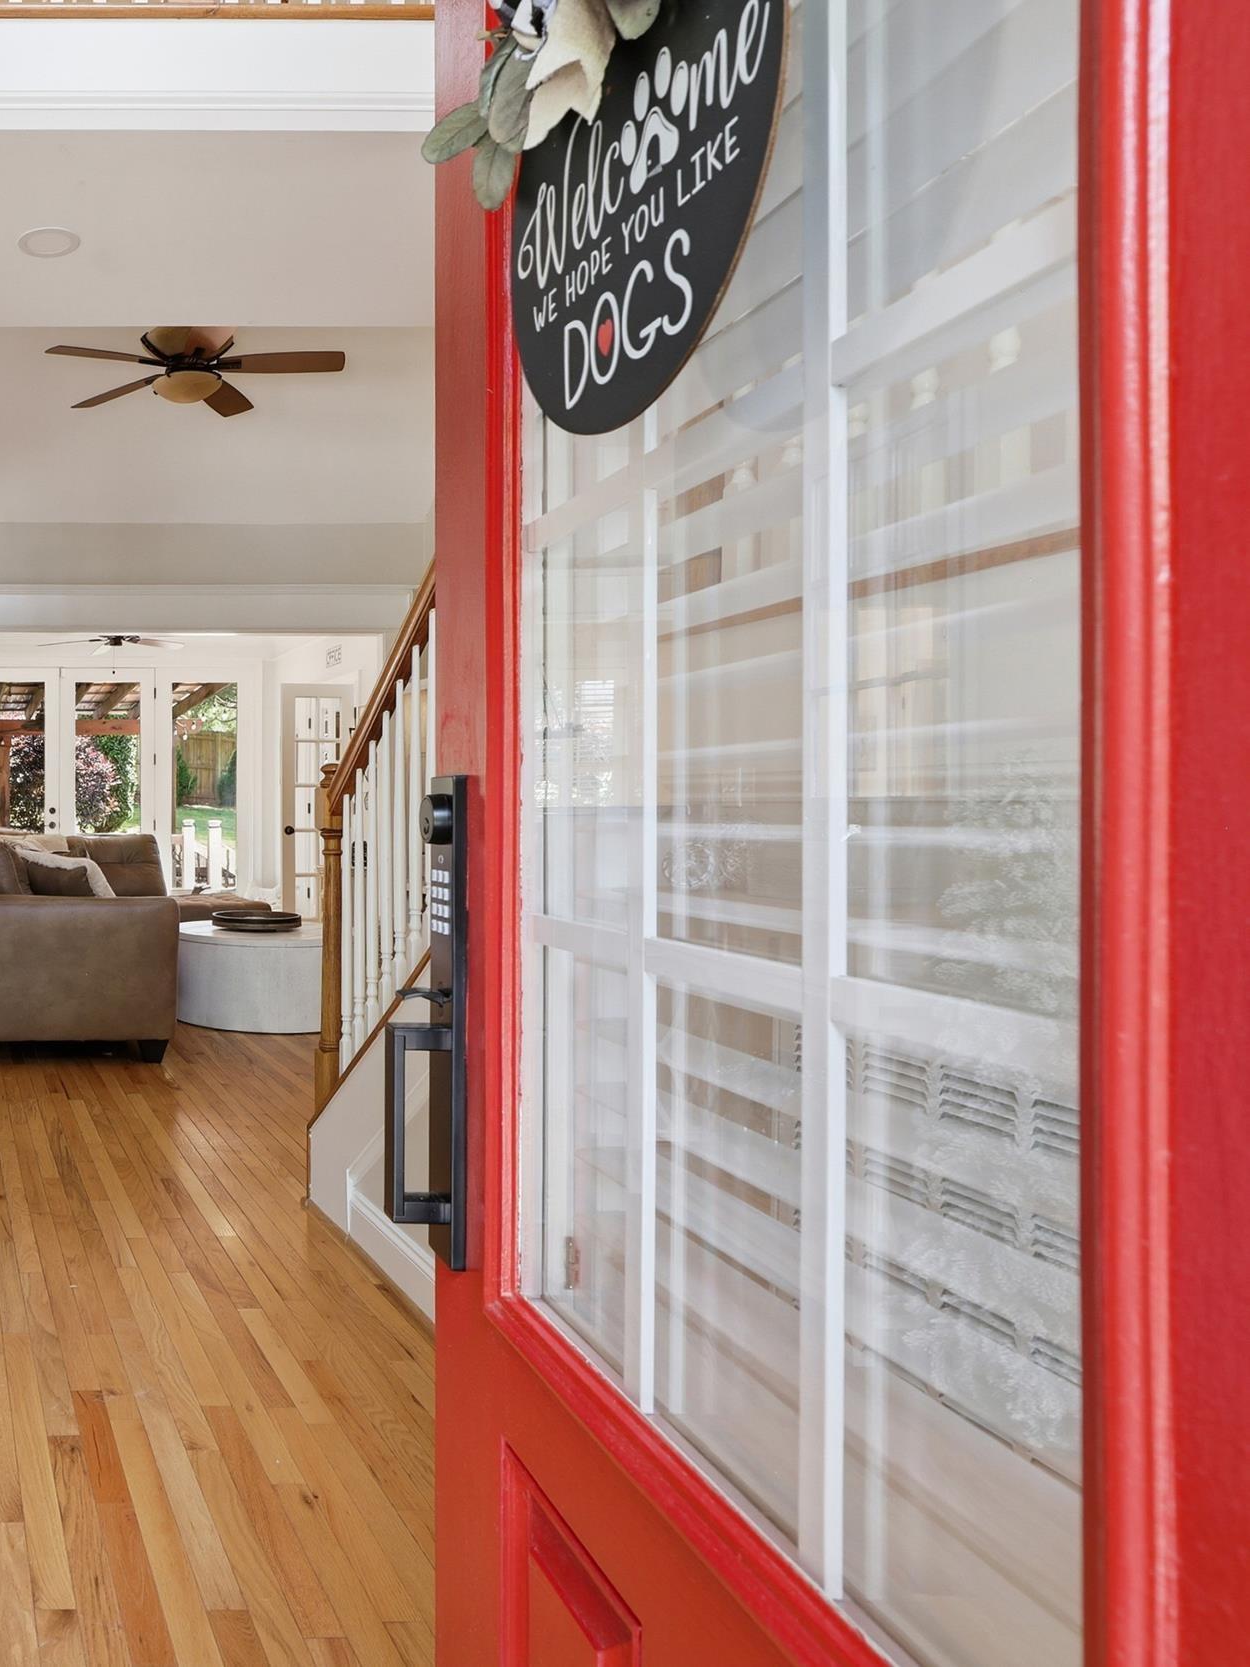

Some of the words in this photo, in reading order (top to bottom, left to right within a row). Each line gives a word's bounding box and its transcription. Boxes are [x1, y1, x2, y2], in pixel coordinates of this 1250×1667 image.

[532, 287, 558, 333] WE
[565, 236, 613, 307] HOPE
[621, 186, 664, 255] YOU
[676, 116, 741, 207] LIKE
[563, 228, 693, 411] DOGS
